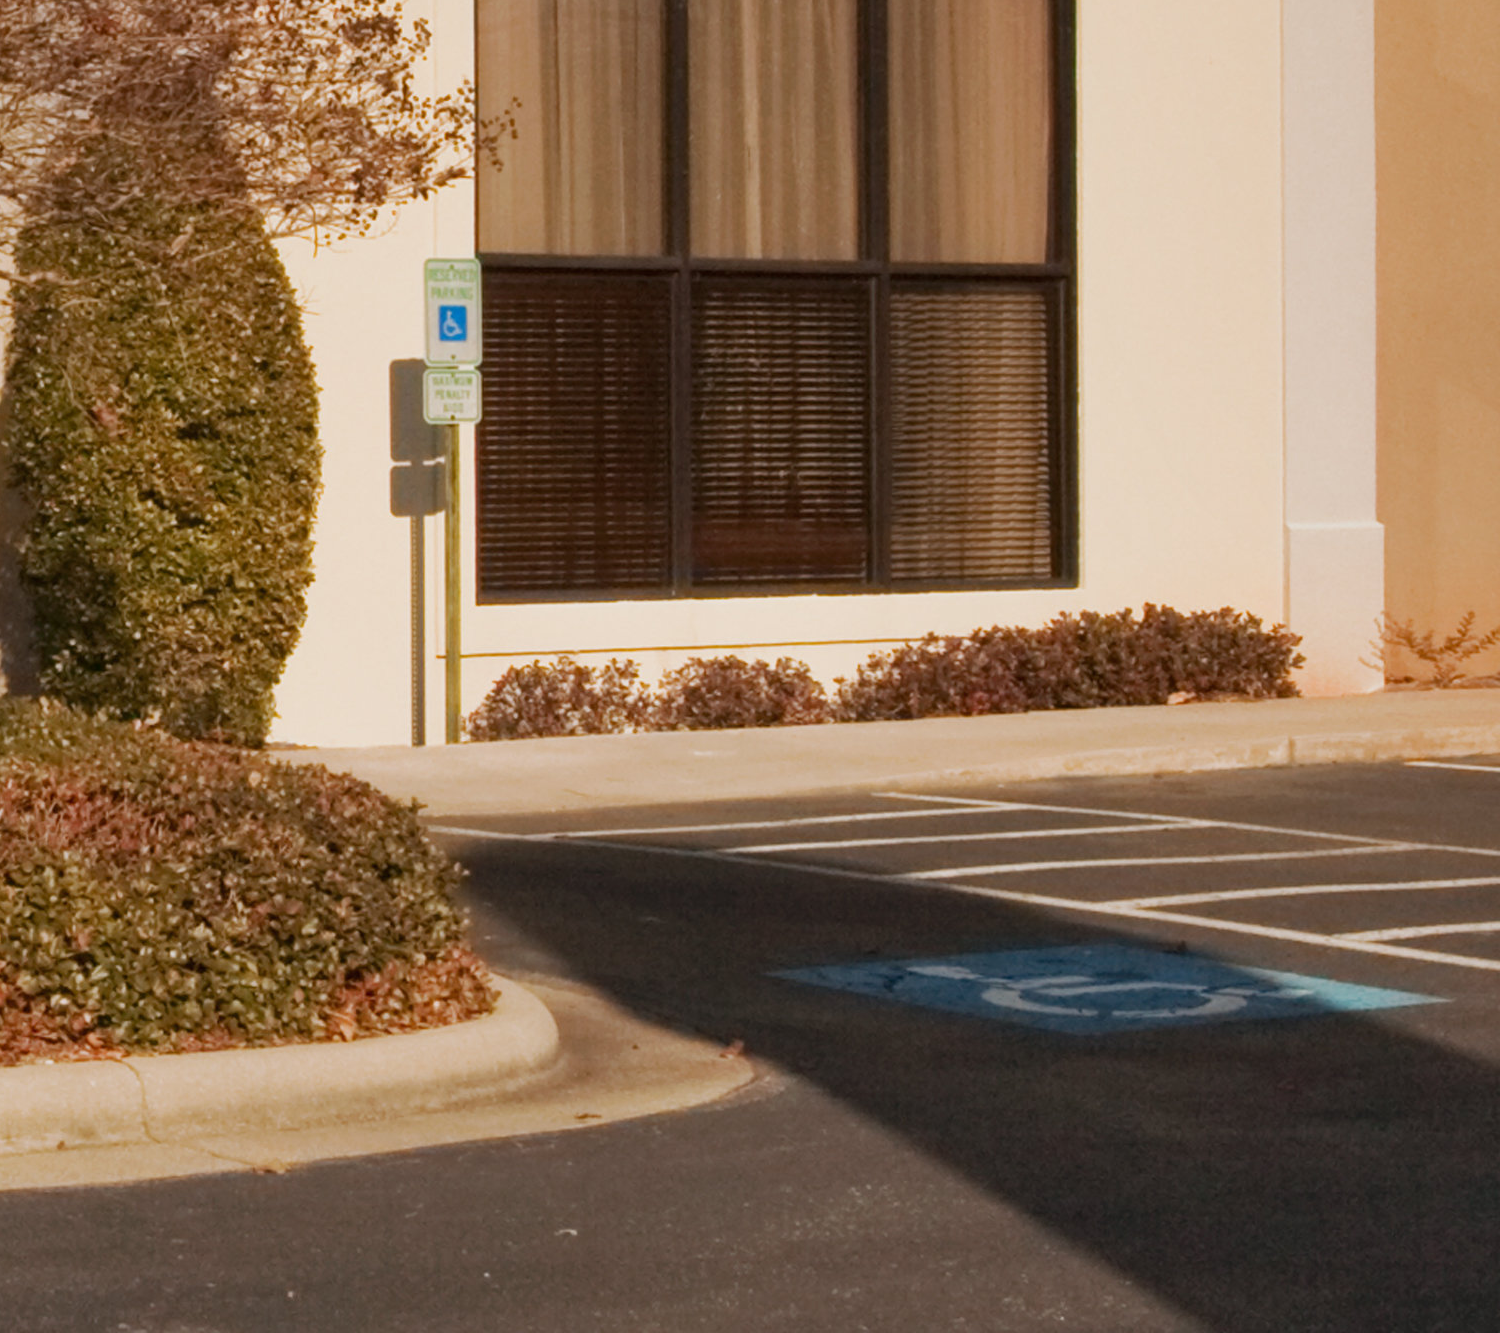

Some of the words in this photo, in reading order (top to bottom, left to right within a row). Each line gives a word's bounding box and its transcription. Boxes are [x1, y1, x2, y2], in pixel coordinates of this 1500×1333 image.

[428, 268, 476, 282] RESERVED
[430, 287, 474, 301] PARKING
[434, 389, 470, 400] PENALTY
